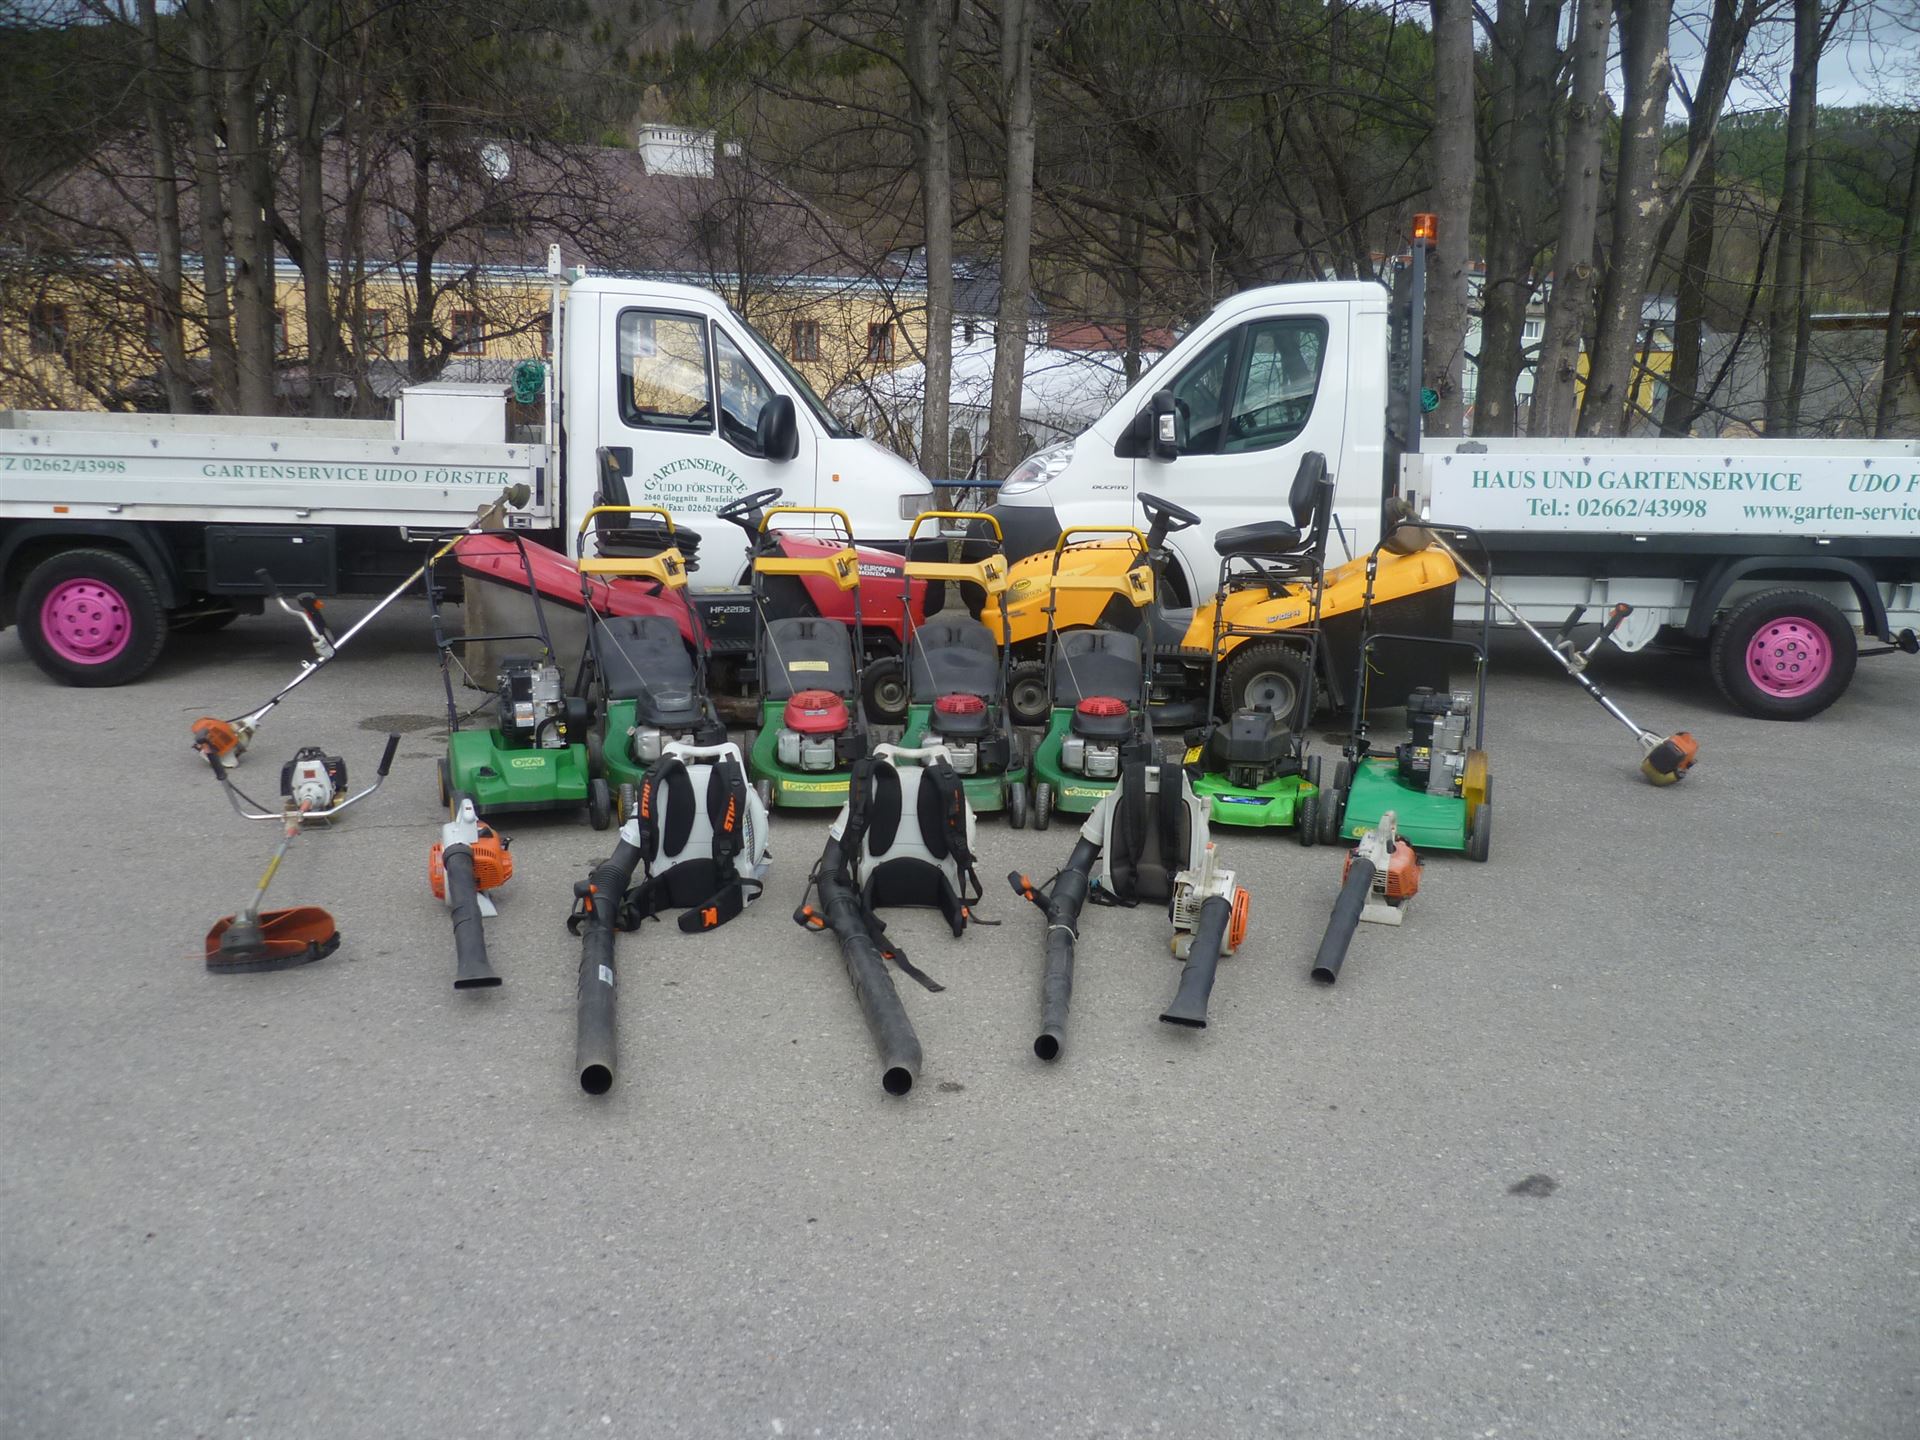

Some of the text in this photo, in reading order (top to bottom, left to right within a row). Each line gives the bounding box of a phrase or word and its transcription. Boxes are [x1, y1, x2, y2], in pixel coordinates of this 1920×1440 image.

[23, 458, 126, 473] 02662/43998
[202, 464, 509, 484] GARTENSERVICE UDO FÖRSTER
[644, 458, 748, 494] GARTENSERVICE
[659, 482, 733, 494] UDO FÖRSTER
[1472, 470, 1536, 489] HAUS
[1543, 470, 1592, 489] UND
[1597, 471, 1802, 491] GARTENSERVICE
[1848, 473, 1901, 493] UDO
[644, 493, 661, 501] 2640
[1526, 498, 1920, 525] Tel.: 02662/43998 www.garten-servic
[641, 782, 652, 818] STIHL
